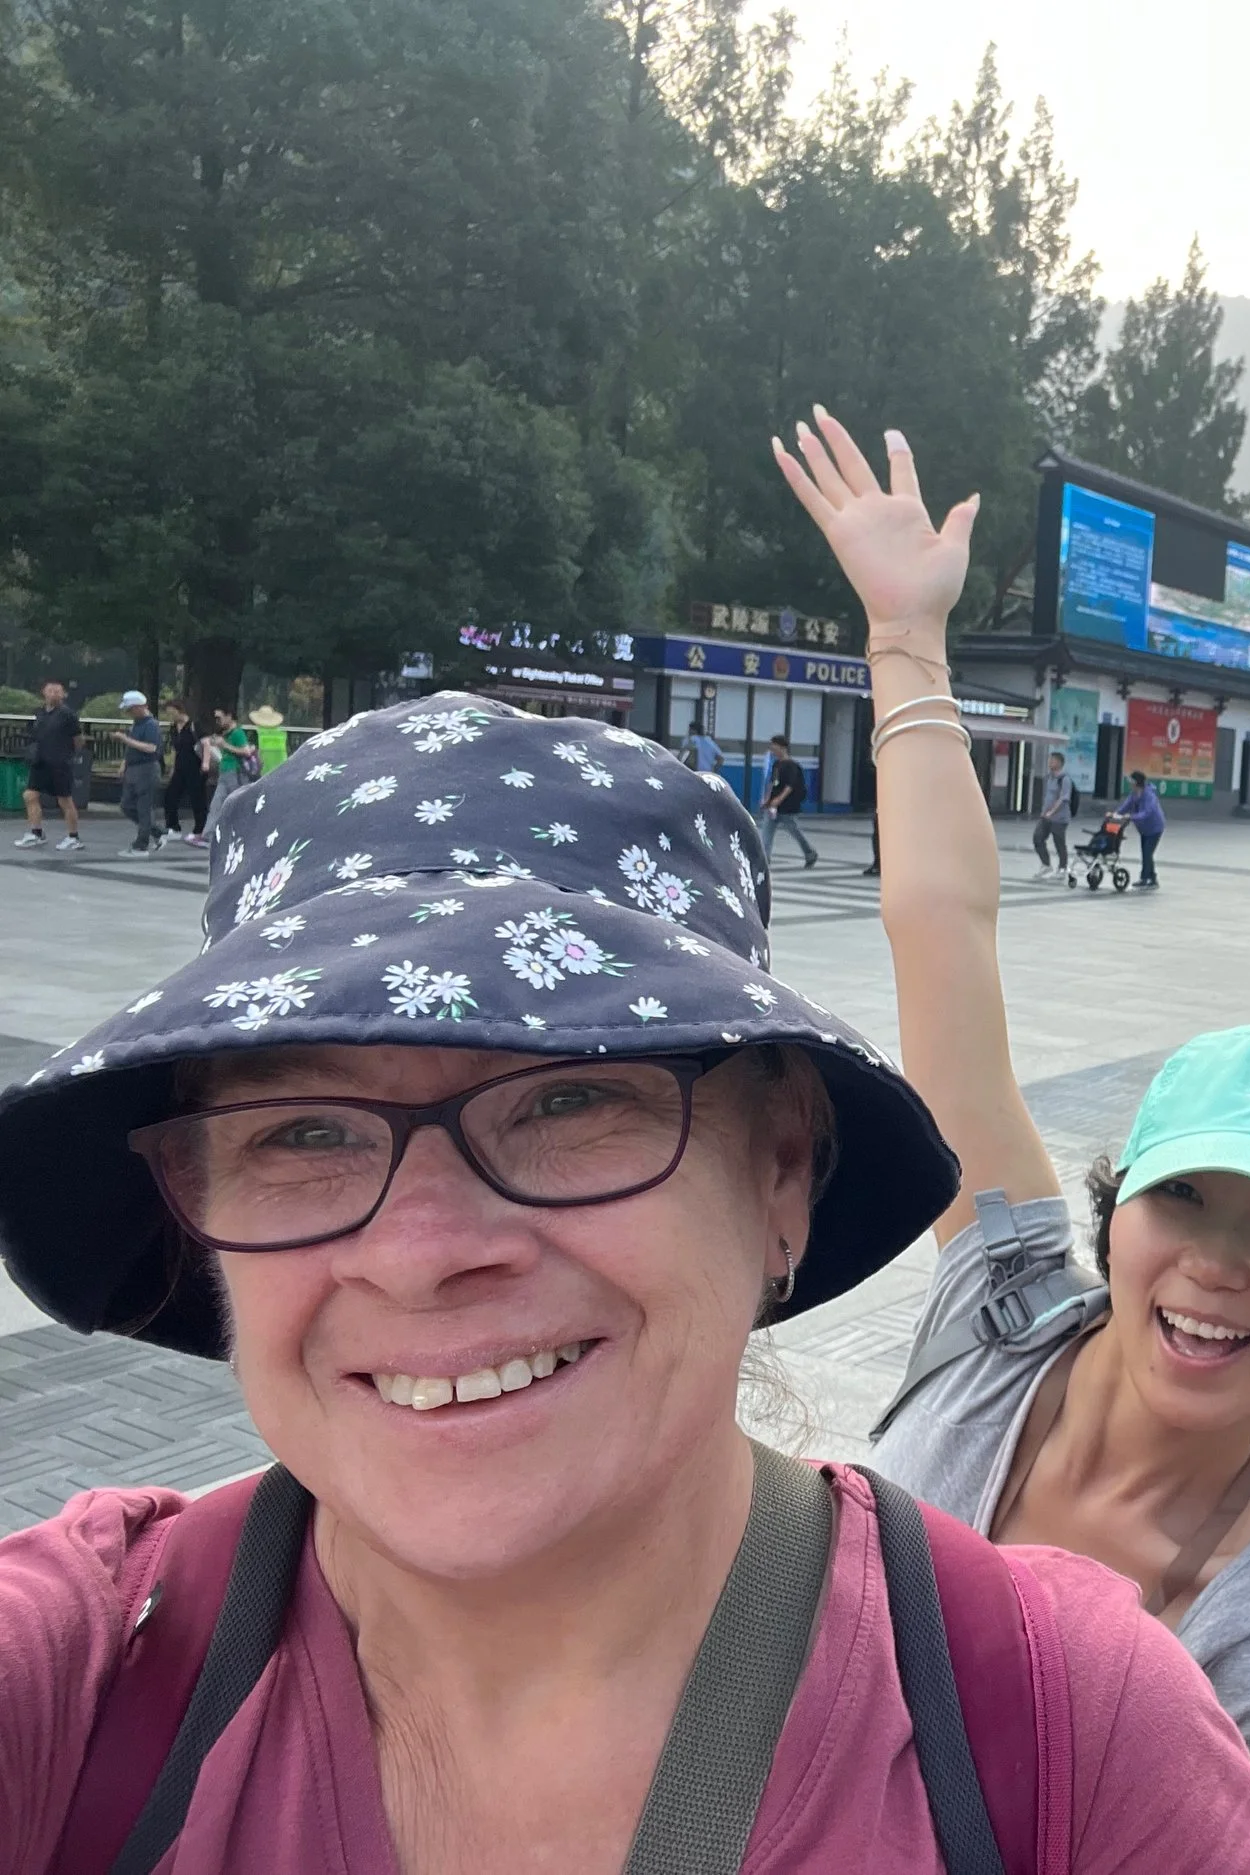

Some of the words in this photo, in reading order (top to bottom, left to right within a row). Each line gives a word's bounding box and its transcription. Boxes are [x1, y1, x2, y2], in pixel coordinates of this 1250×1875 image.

[805, 618, 839, 646] 公安
[563, 670, 584, 685] Ticket
[584, 673, 604, 687] Office
[805, 661, 866, 686] POLICE
